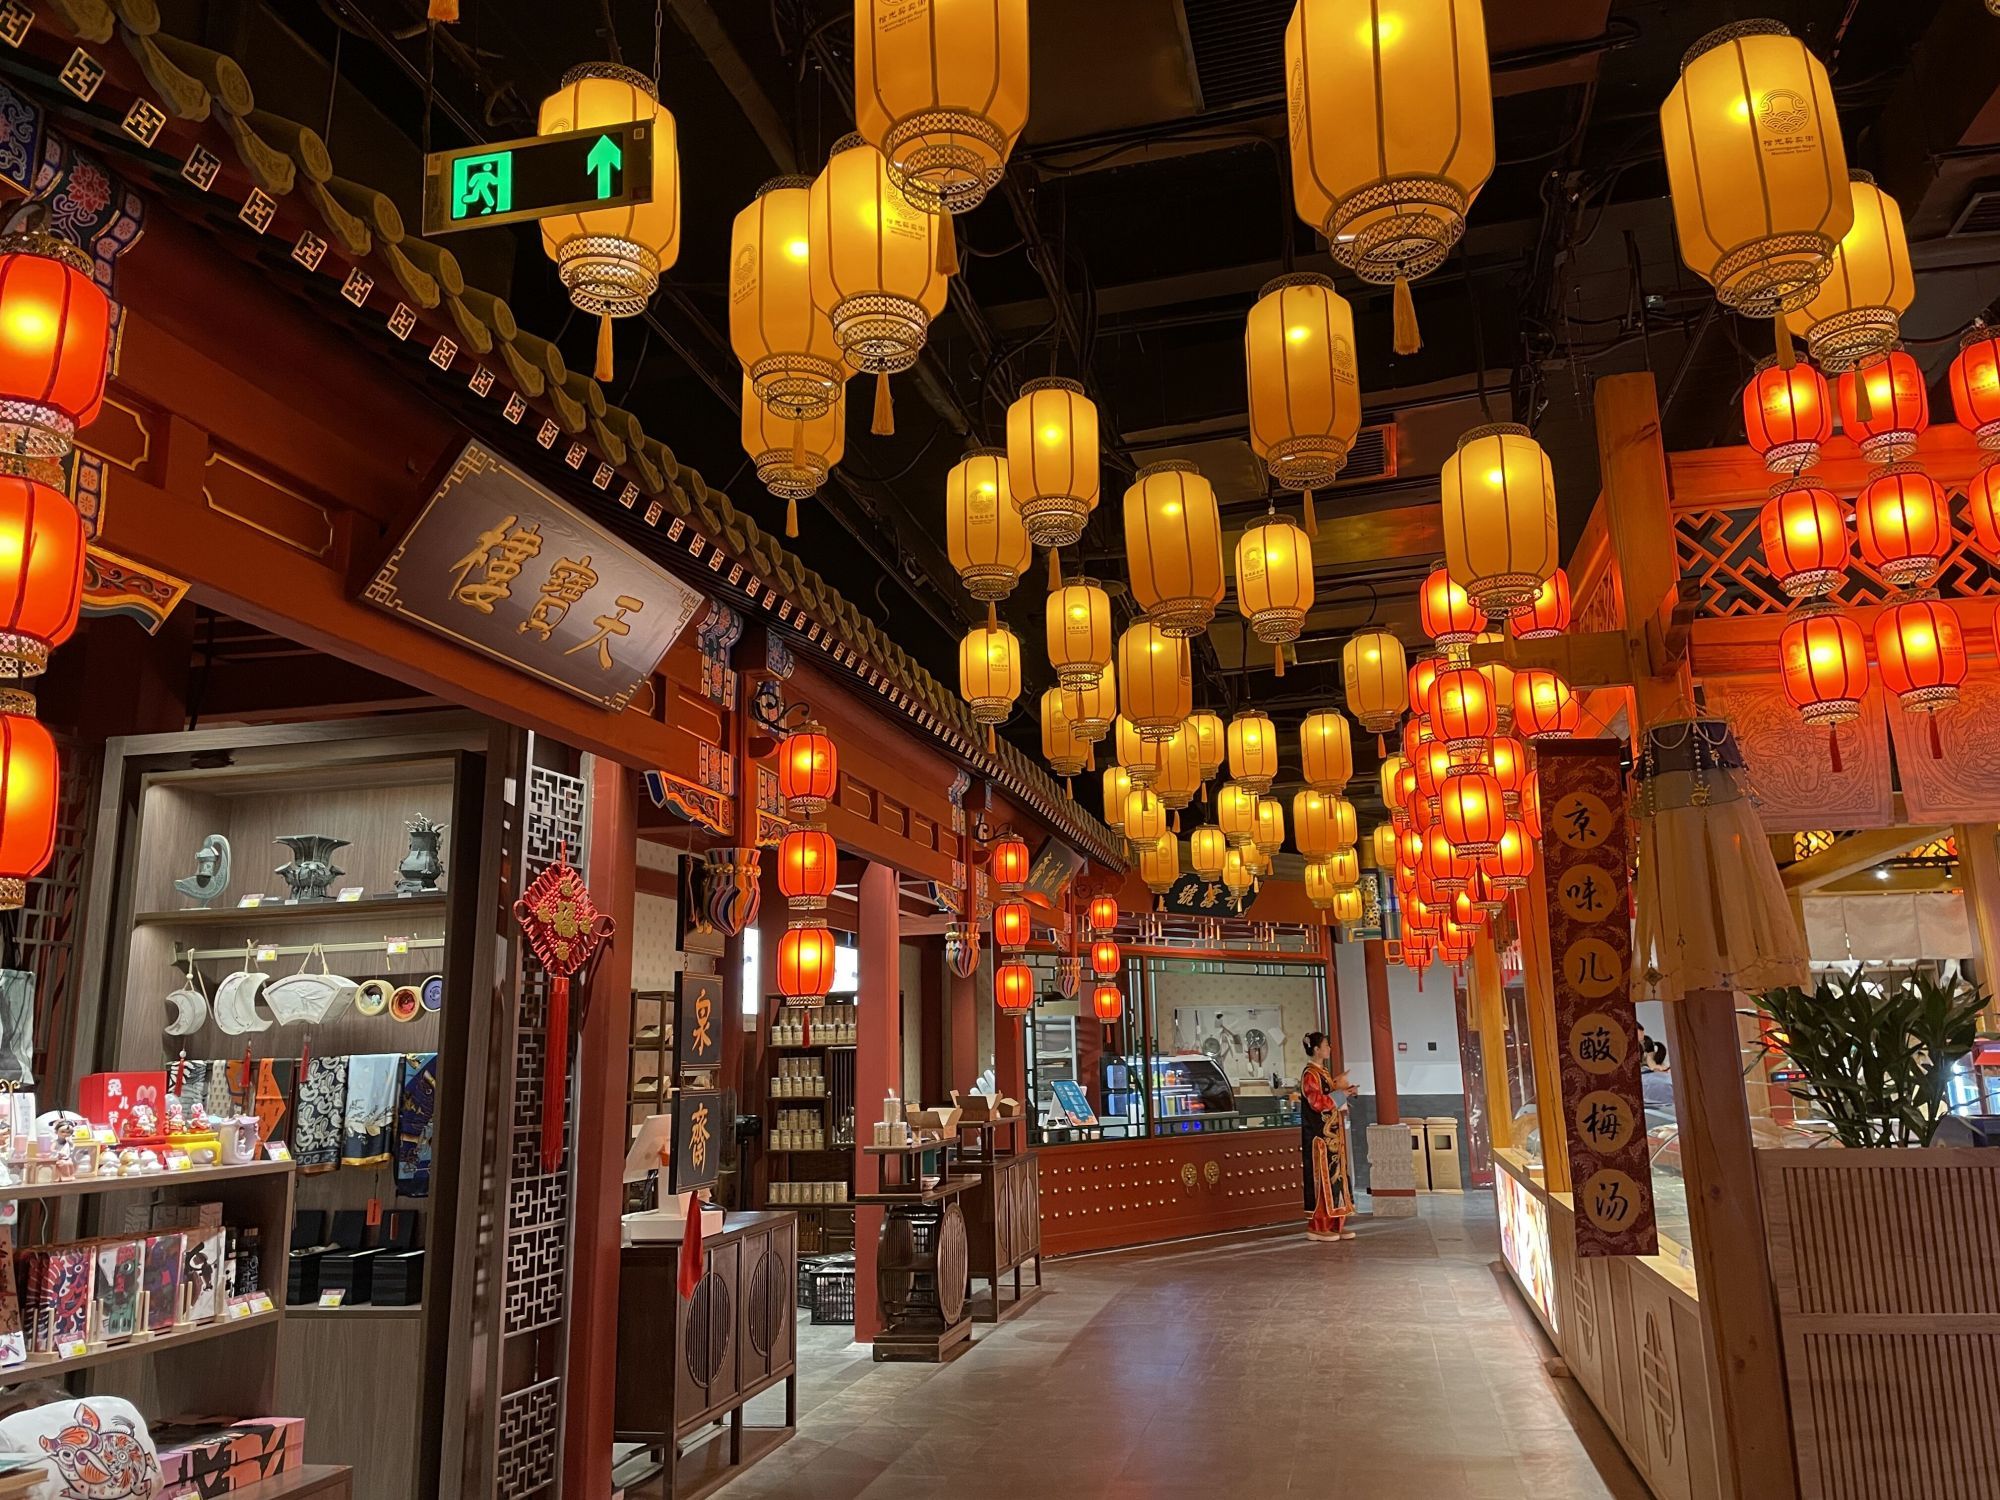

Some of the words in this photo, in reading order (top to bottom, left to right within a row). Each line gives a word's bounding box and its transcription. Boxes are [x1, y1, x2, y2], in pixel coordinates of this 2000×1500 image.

[1562, 800, 1629, 1223] 京味儿酸梅汤
